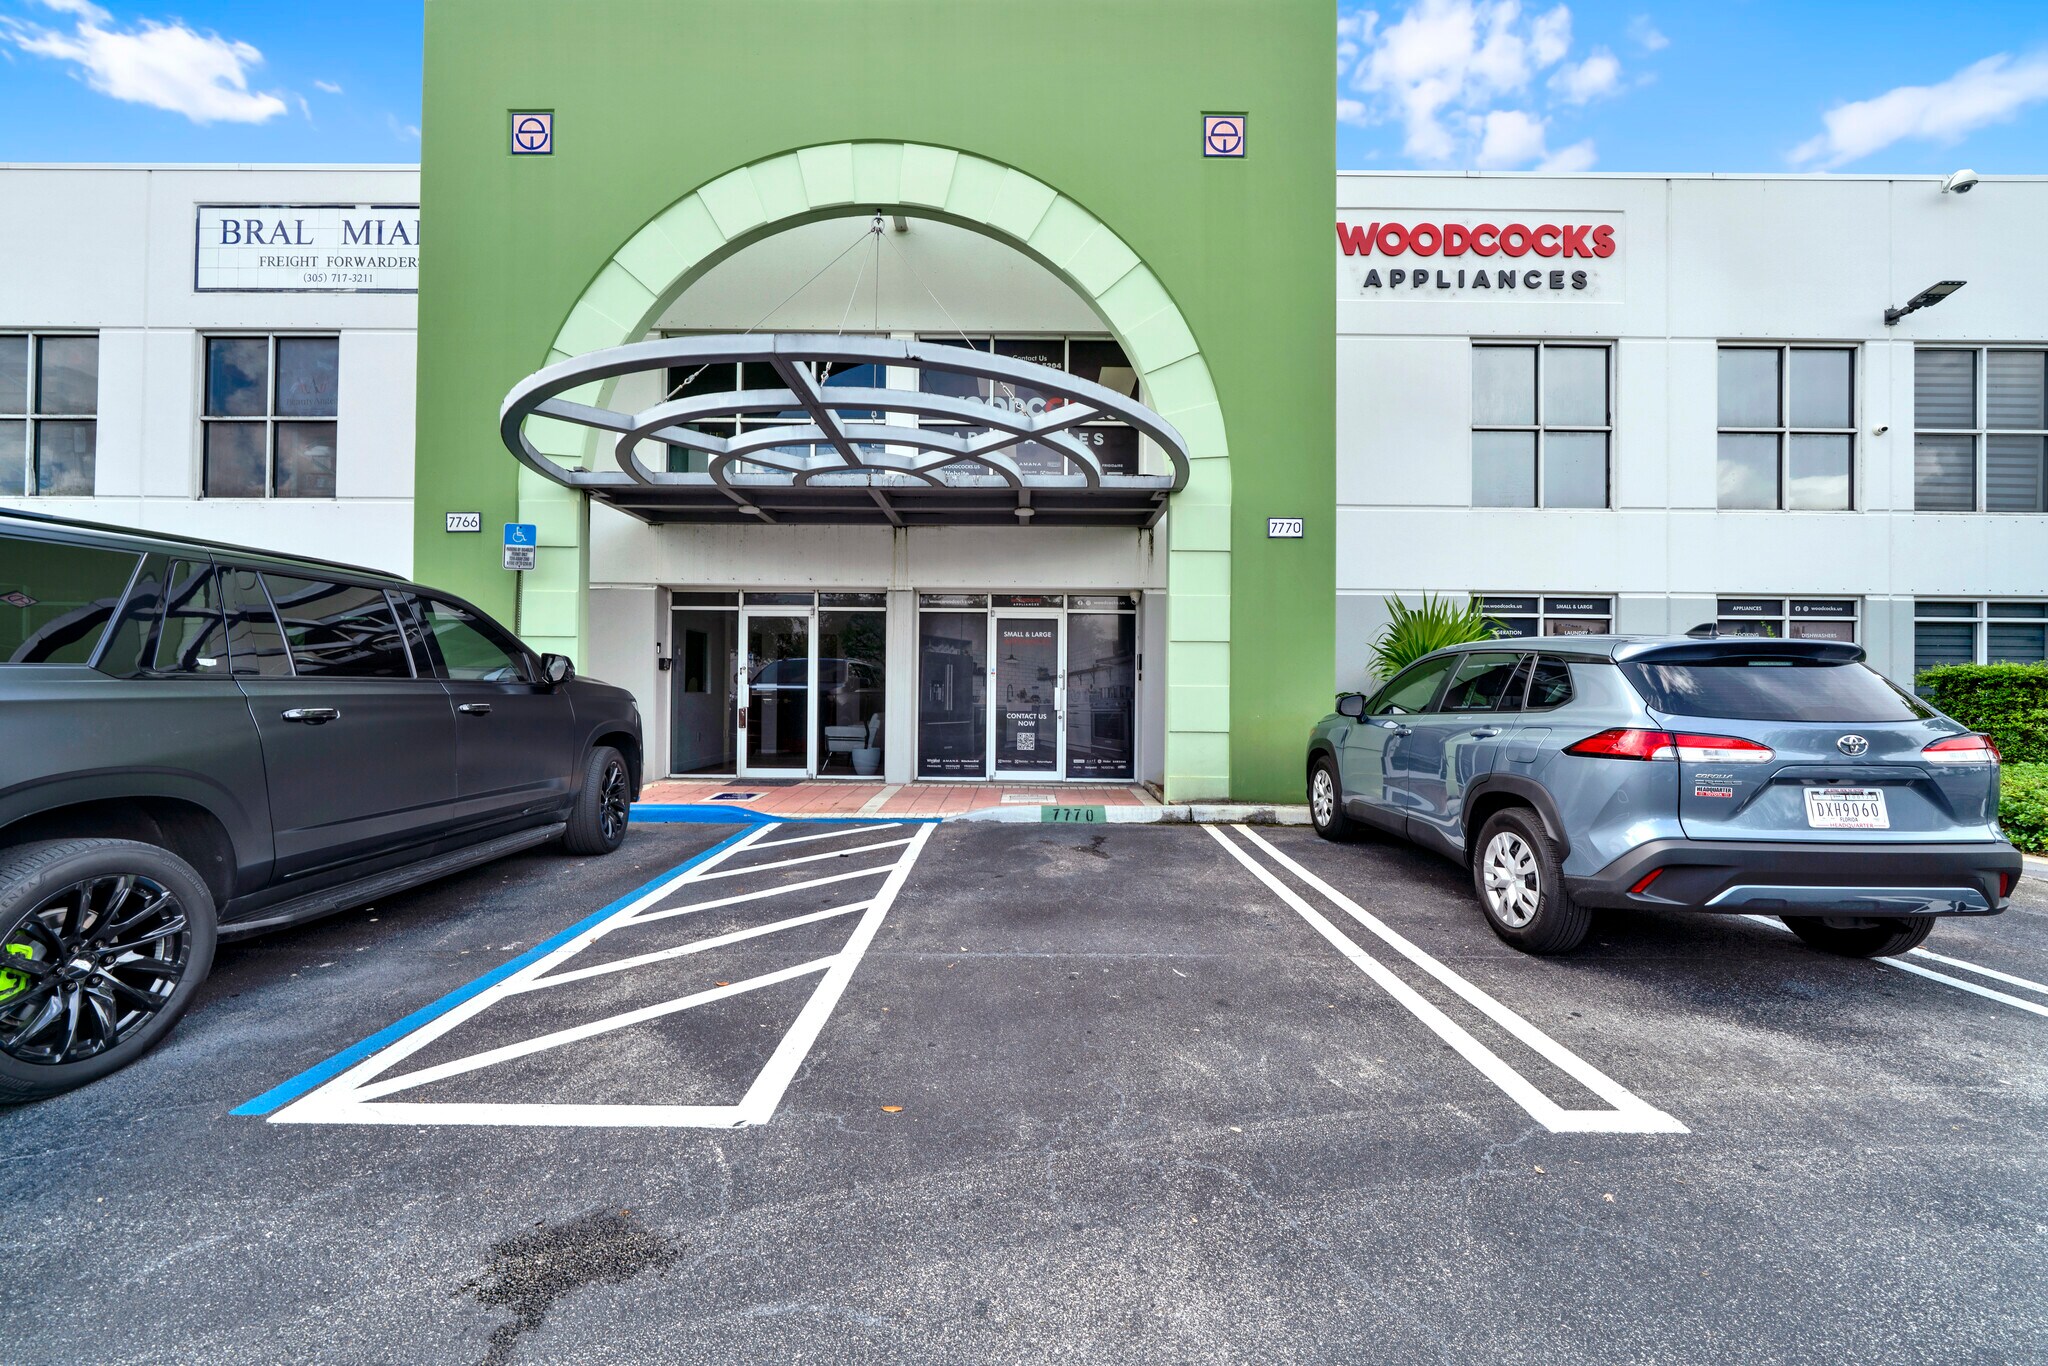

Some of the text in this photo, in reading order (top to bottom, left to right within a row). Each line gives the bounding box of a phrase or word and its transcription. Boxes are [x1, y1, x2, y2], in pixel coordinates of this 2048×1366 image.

[219, 219, 315, 245] BRAL
[1337, 222, 1616, 258] WOODCOCKS
[259, 255, 420, 269] FREIGHT FORWARDER
[303, 272, 373, 284] (305) 717-3211
[1363, 268, 1588, 290] APPLIANCES
[449, 516, 478, 528] 7766
[1271, 522, 1301, 534] 7770
[1052, 808, 1094, 822] 7770
[1817, 802, 1879, 818] DXH9060
[0, 880, 37, 914] ENZA
